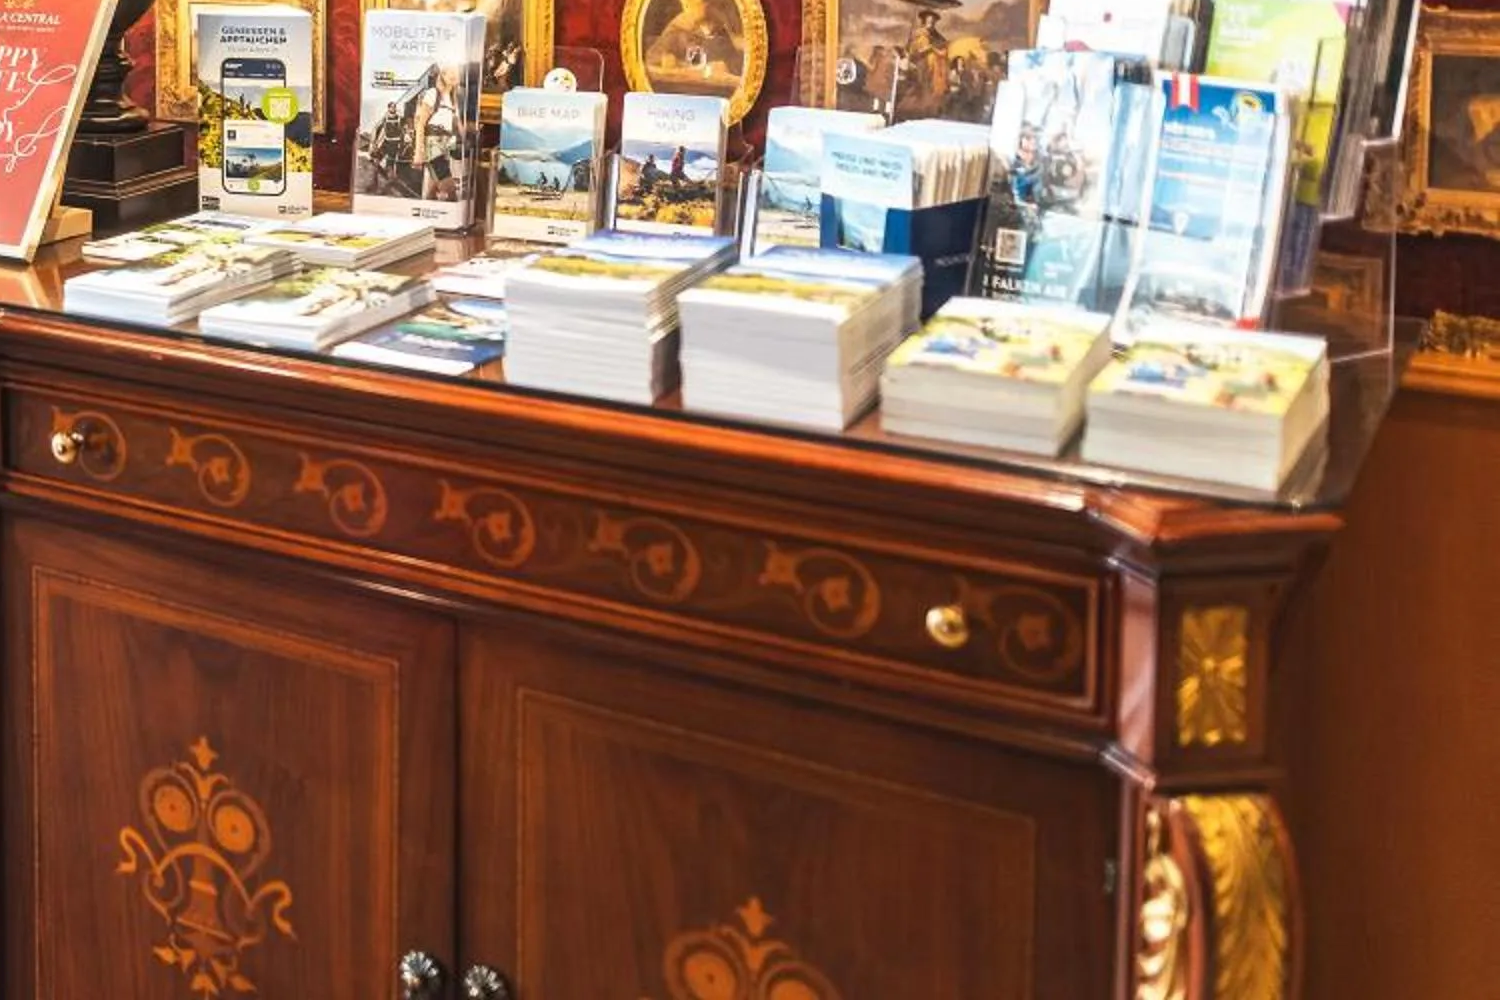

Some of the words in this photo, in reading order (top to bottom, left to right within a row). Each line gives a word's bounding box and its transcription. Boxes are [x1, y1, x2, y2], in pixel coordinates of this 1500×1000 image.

[372, 25, 457, 40] MOBILITÄTS-
[391, 40, 437, 53] KARTE
[517, 107, 547, 119] BIKE
[551, 107, 580, 120] MAP
[647, 108, 696, 121] HIKING
